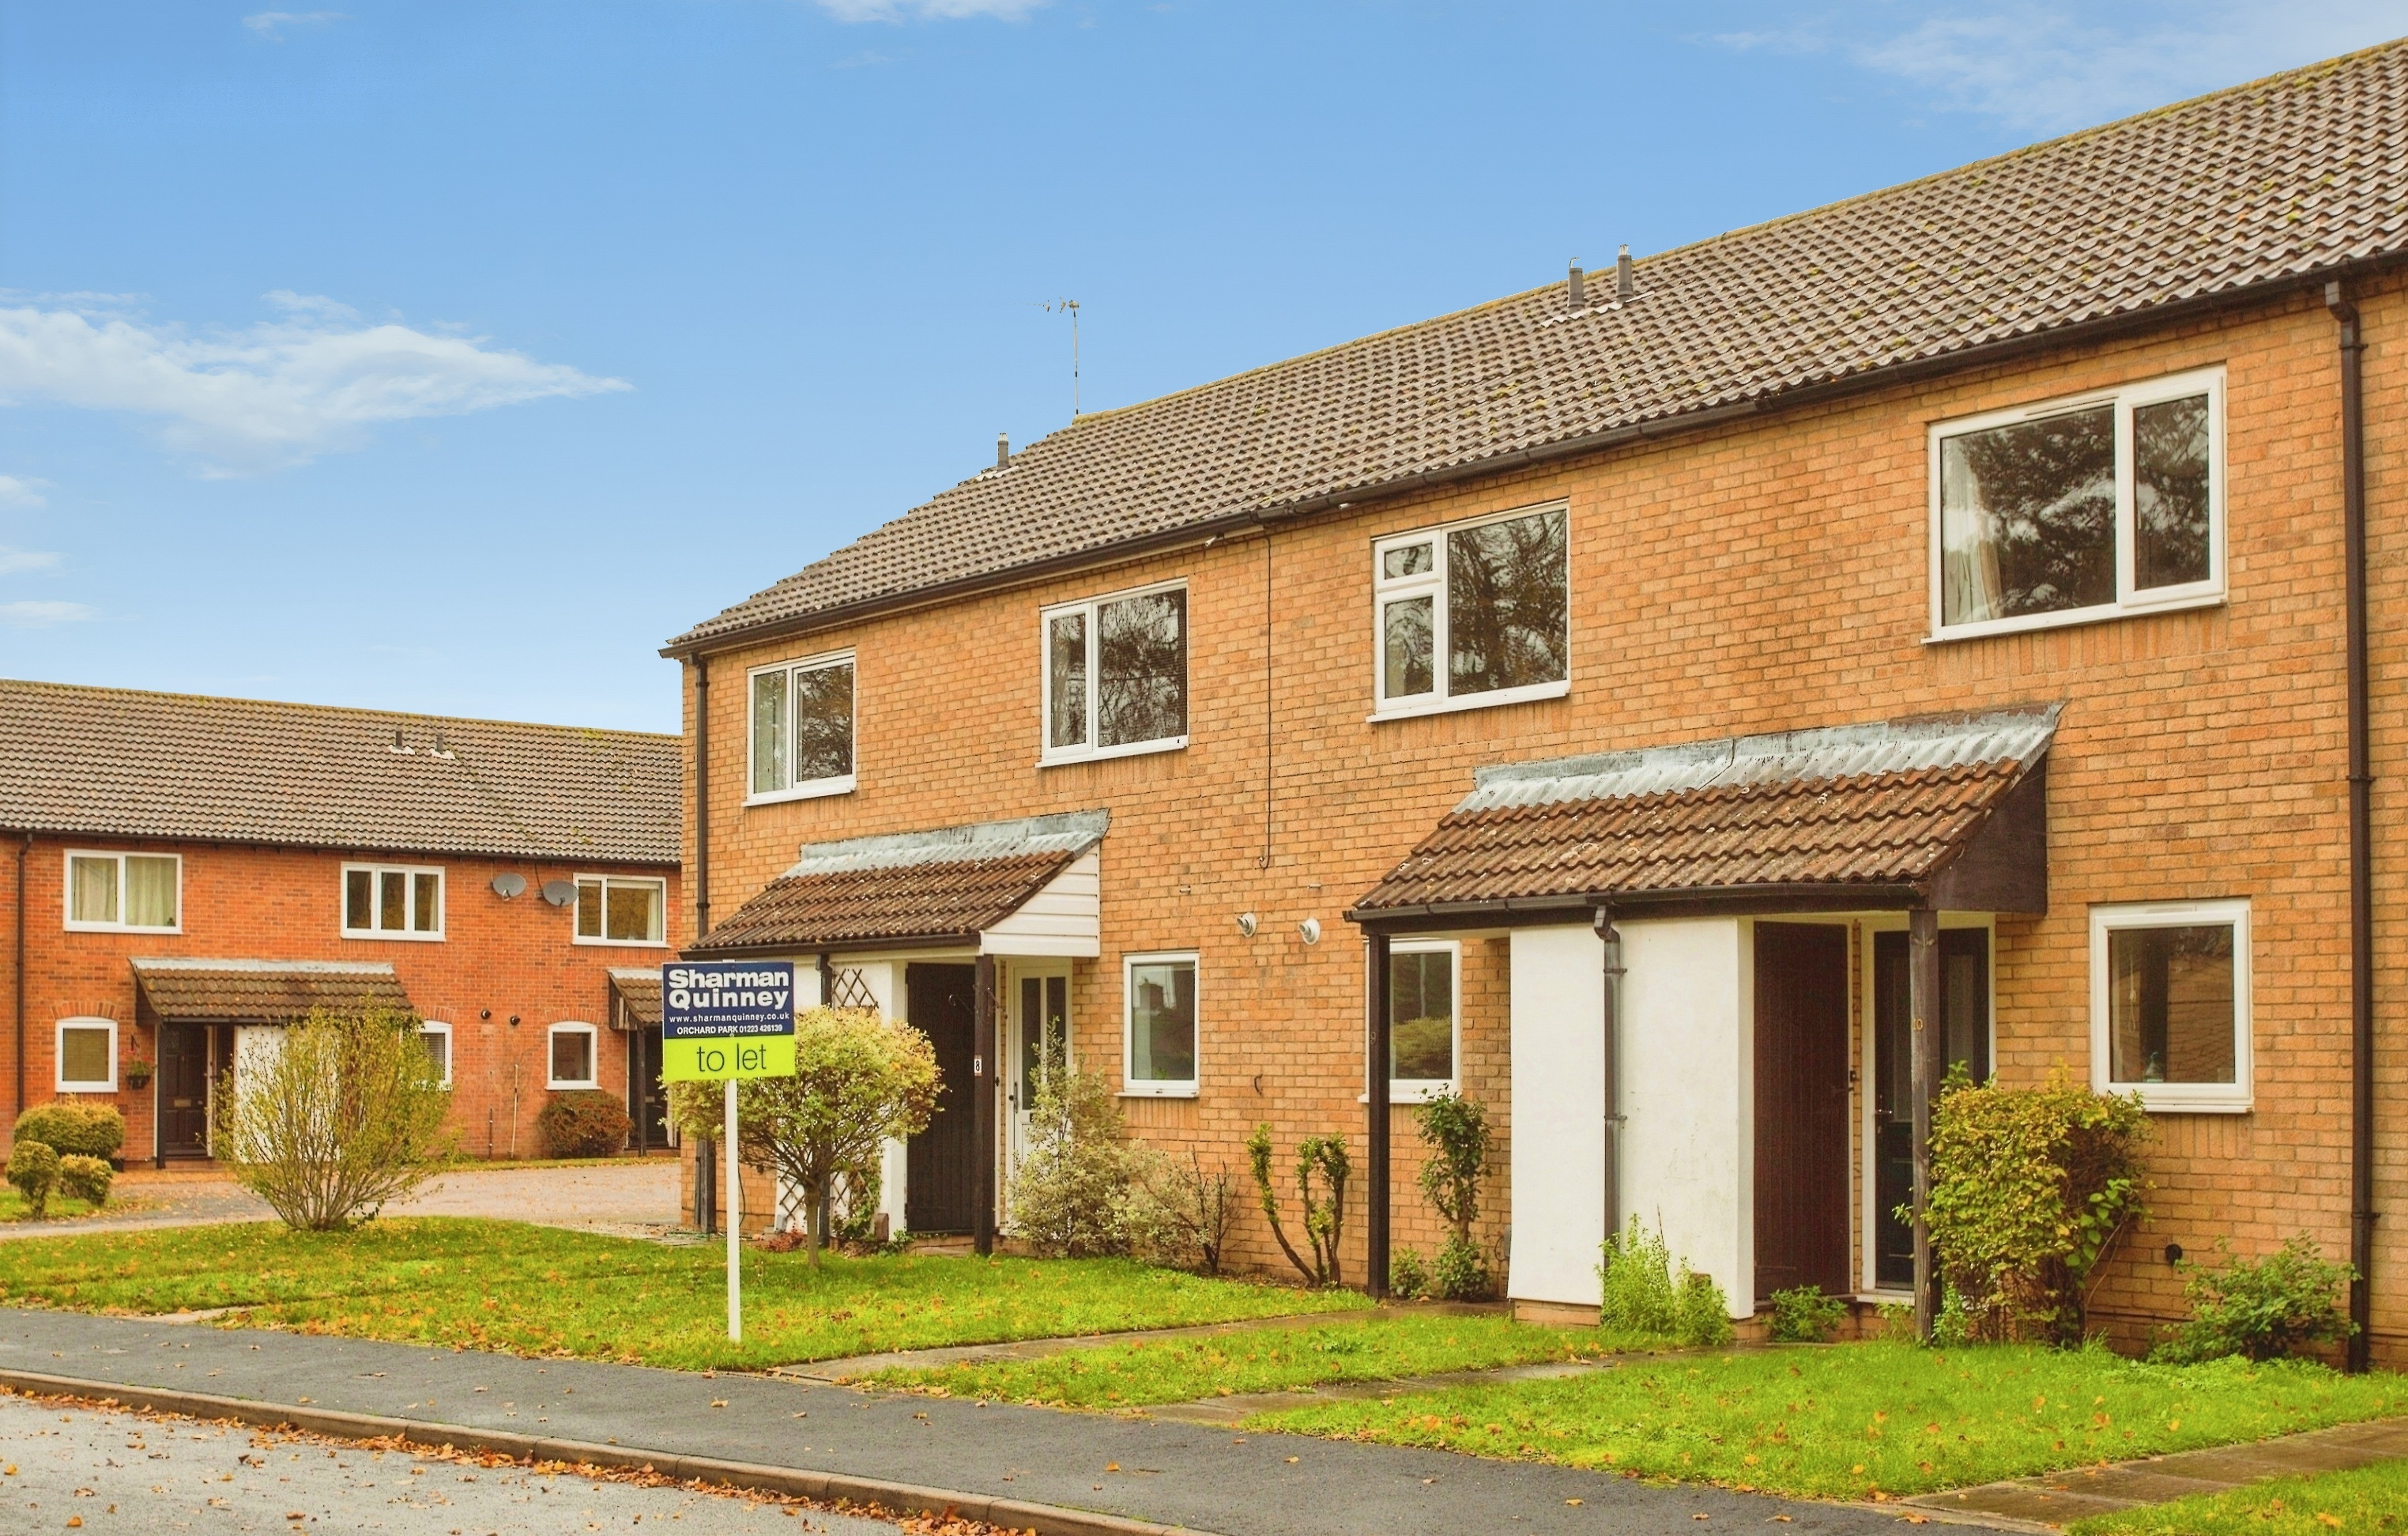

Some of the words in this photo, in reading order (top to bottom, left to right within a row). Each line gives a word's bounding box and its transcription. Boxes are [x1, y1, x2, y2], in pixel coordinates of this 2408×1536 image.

[669, 969, 789, 989] Sharman
[669, 988, 789, 1011] Quinney
[669, 1012, 789, 1023] www.sharmanquinney.co.uk
[676, 1026, 716, 1035] ORCHARD
[718, 1025, 738, 1034] PARK
[739, 1025, 758, 1033] 01223
[1913, 1018, 1923, 1031] 10
[1370, 1032, 1377, 1045] 9
[697, 1046, 725, 1072] to
[737, 1043, 767, 1070] let
[975, 1060, 980, 1071] 8
